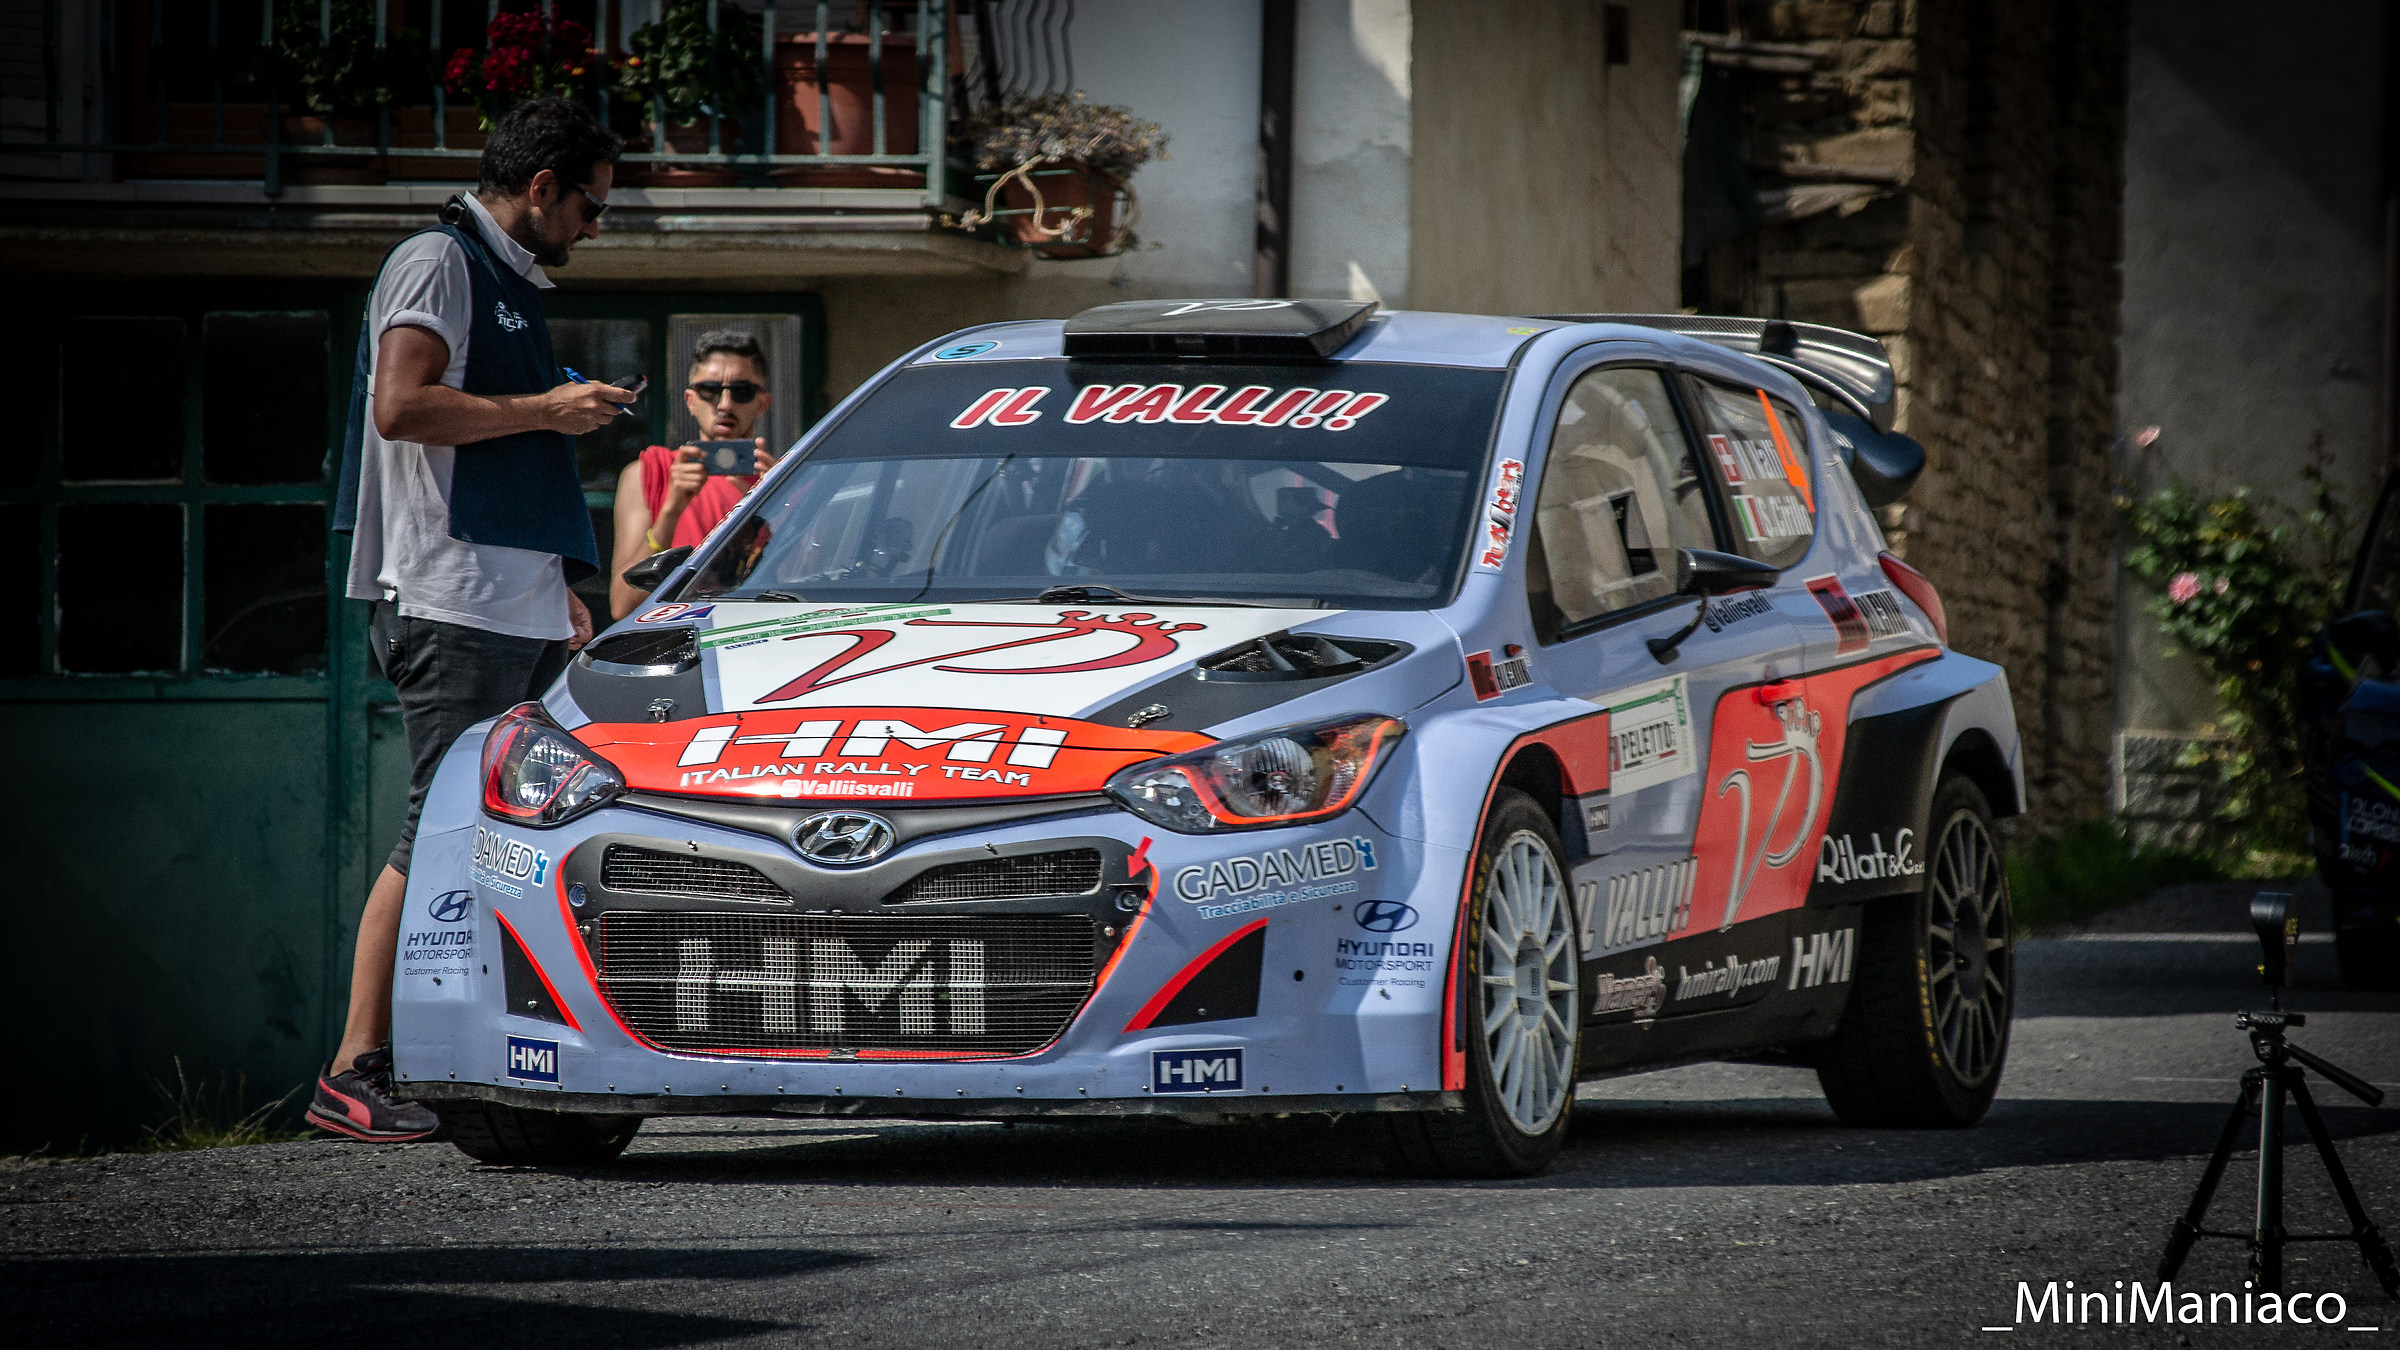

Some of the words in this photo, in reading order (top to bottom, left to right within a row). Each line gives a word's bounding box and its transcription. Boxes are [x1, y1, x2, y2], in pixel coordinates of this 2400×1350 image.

[950, 386, 1051, 429] IL
[1063, 384, 1389, 431] VALLI!!
[1756, 388, 1816, 514] 4
[677, 719, 1069, 769] HMI
[680, 762, 806, 788] ITALIAN
[813, 762, 931, 777] RALLY
[940, 765, 1031, 787] TEAM
[778, 779, 915, 799] @Valliisvalli
[1301, 880, 1359, 901] Sicurezza
[1604, 856, 1698, 949] VALLI!!
[407, 929, 473, 947] HYUNDA
[1335, 938, 1434, 958] HYUNDAI
[403, 948, 473, 961] MOTORSPOR
[1334, 957, 1435, 972] MOTORSPORT
[1788, 928, 1854, 991] HMI
[404, 967, 441, 976] Customer
[442, 966, 469, 977] Racing
[1338, 976, 1388, 987] Customer
[1390, 976, 1426, 989] Racing
[1676, 955, 1780, 1001] hmirally.com
[675, 937, 986, 1034] HMI
[510, 1045, 554, 1074] HMI
[1159, 1057, 1237, 1084] HMI
